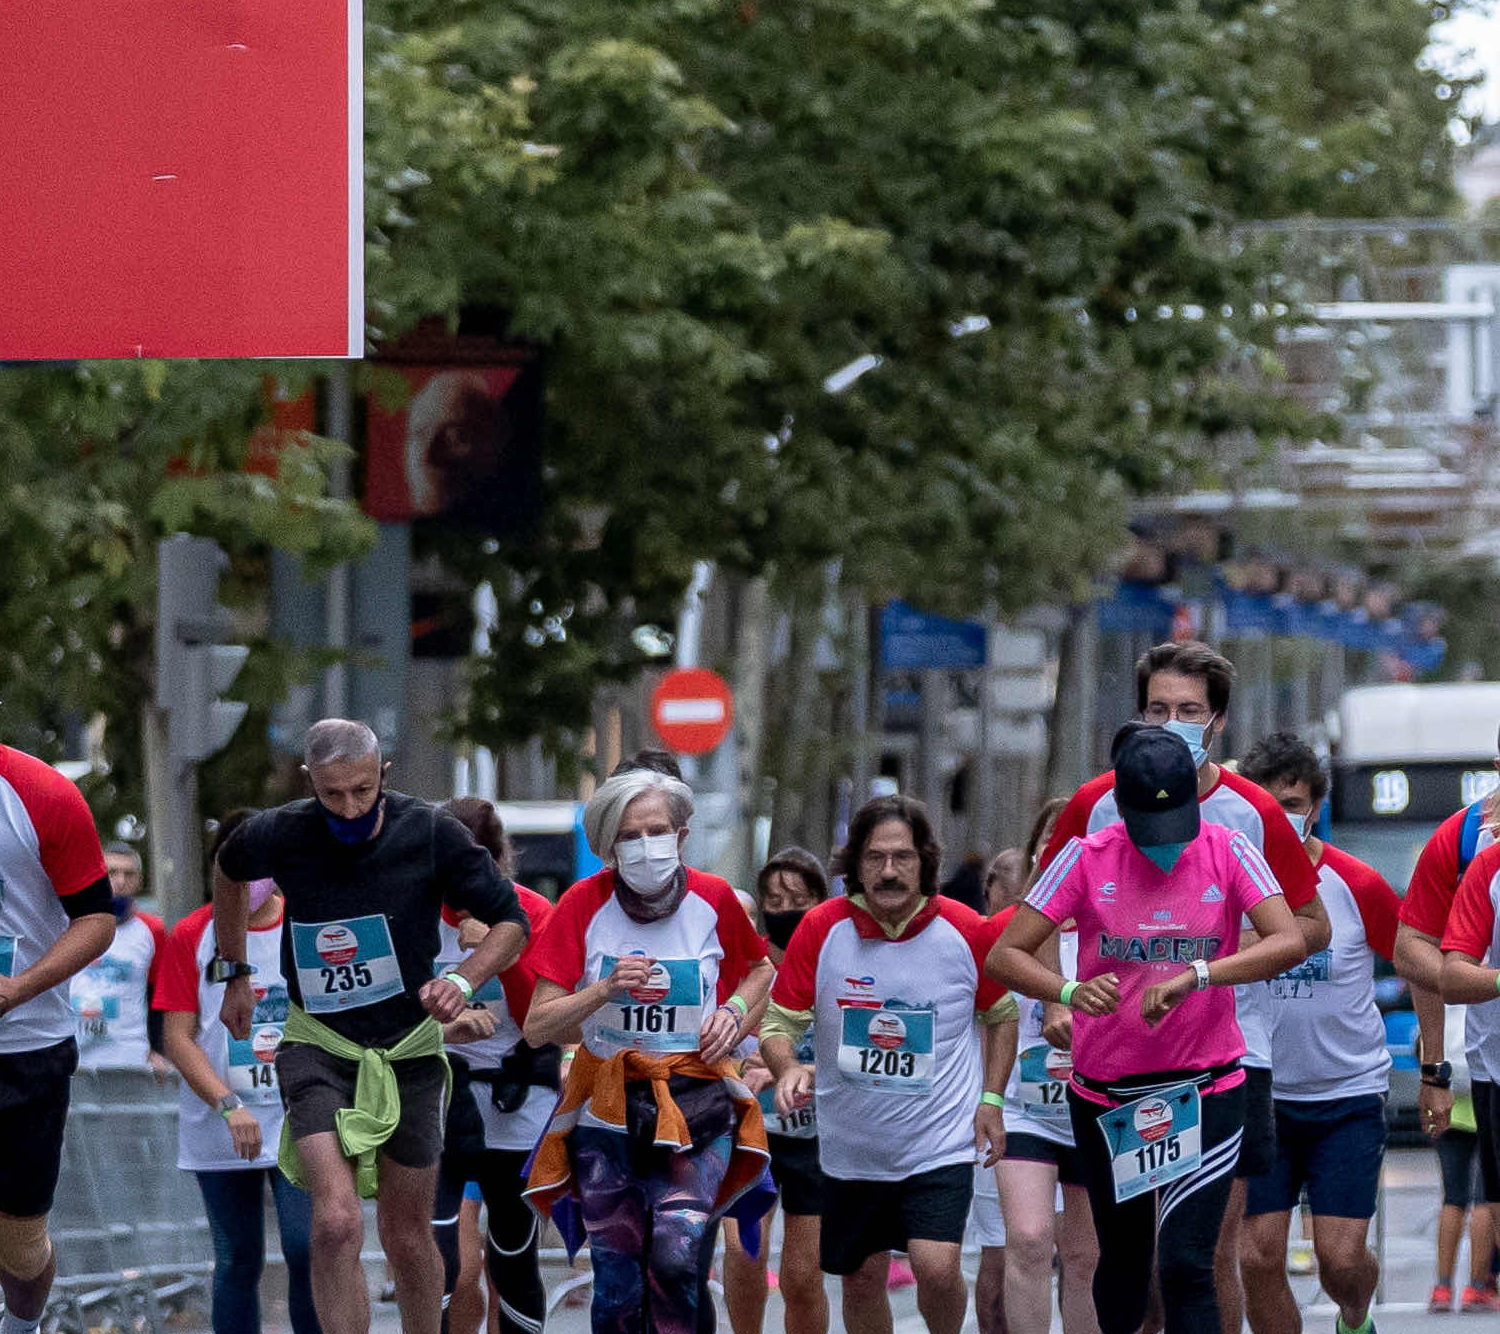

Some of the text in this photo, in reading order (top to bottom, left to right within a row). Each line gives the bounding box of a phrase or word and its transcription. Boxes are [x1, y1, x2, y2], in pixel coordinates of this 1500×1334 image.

[1099, 933, 1221, 964] MADRID
[320, 962, 373, 994] 235
[621, 1005, 677, 1033] 1161
[248, 1064, 277, 1088] 14
[859, 1049, 916, 1078] 1203
[1135, 1134, 1181, 1174] 1175
